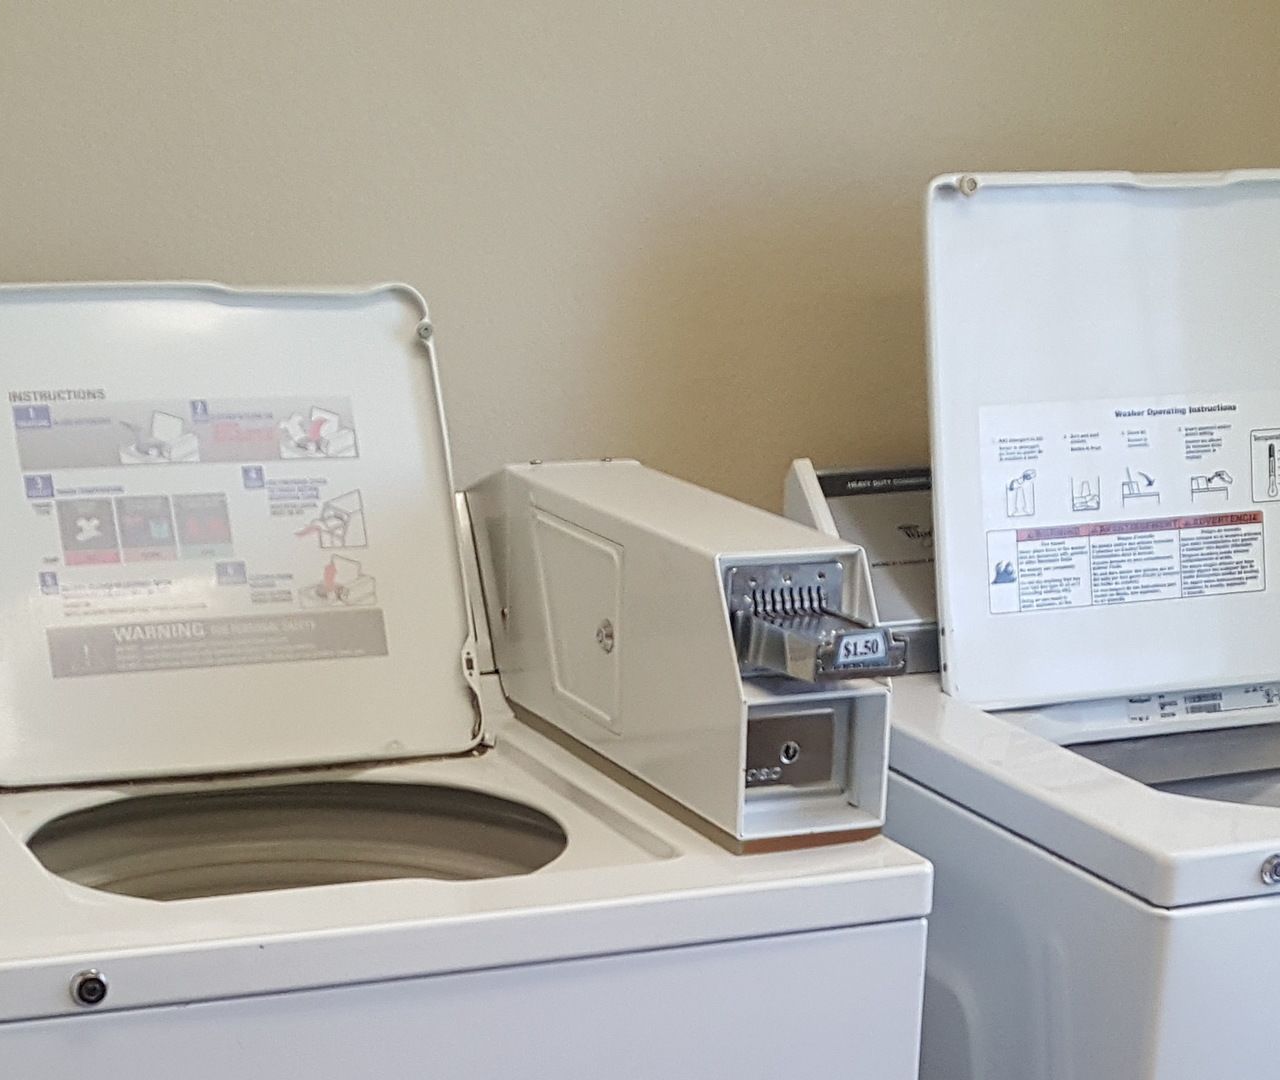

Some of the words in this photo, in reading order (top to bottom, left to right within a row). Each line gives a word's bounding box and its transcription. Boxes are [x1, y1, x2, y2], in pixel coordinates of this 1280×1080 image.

[8, 388, 107, 402] INSTRUCTIONS
[1147, 407, 1187, 416] Operating
[1188, 404, 1237, 414] Instructions
[112, 621, 206, 643] WARNING
[842, 638, 880, 658] $1.50
